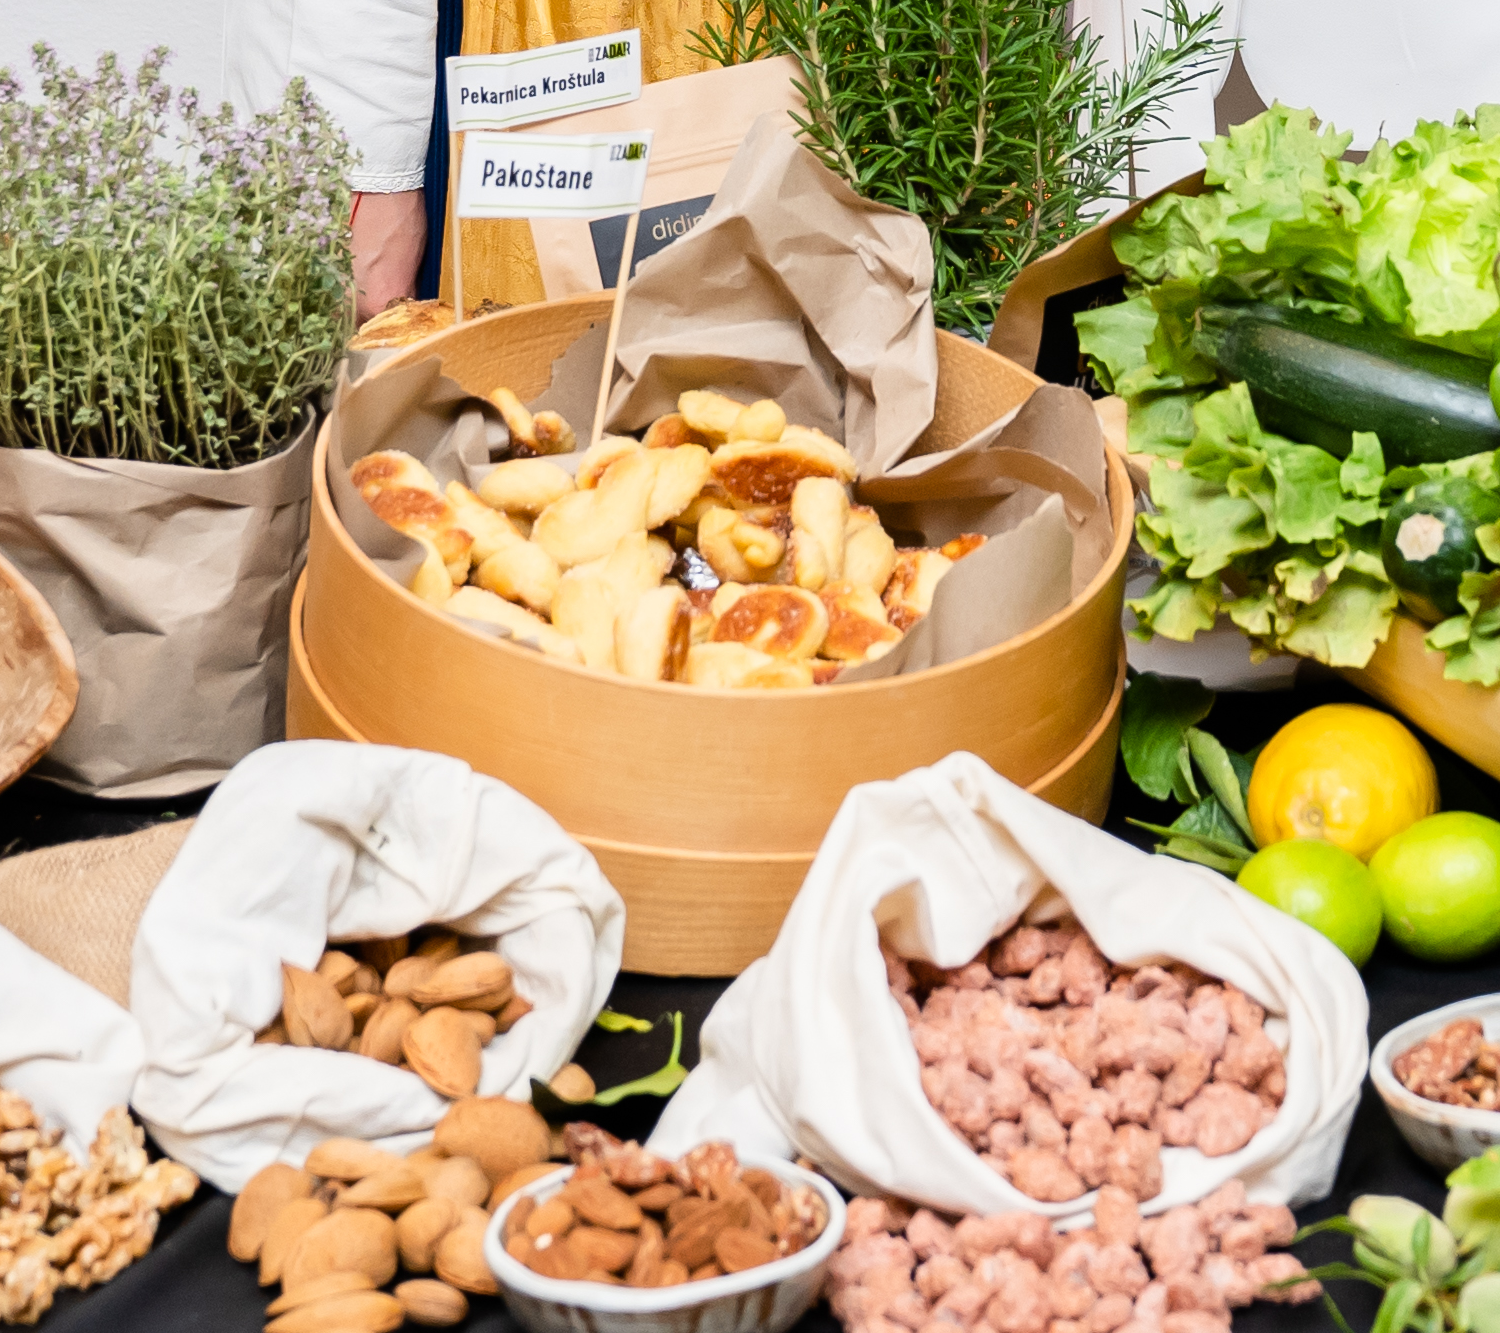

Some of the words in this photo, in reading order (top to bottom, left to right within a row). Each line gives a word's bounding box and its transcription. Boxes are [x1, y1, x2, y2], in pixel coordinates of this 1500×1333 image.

[461, 83, 537, 105] Pekarnica
[542, 68, 605, 95] Kroštula
[482, 159, 593, 190] Pakoštane
